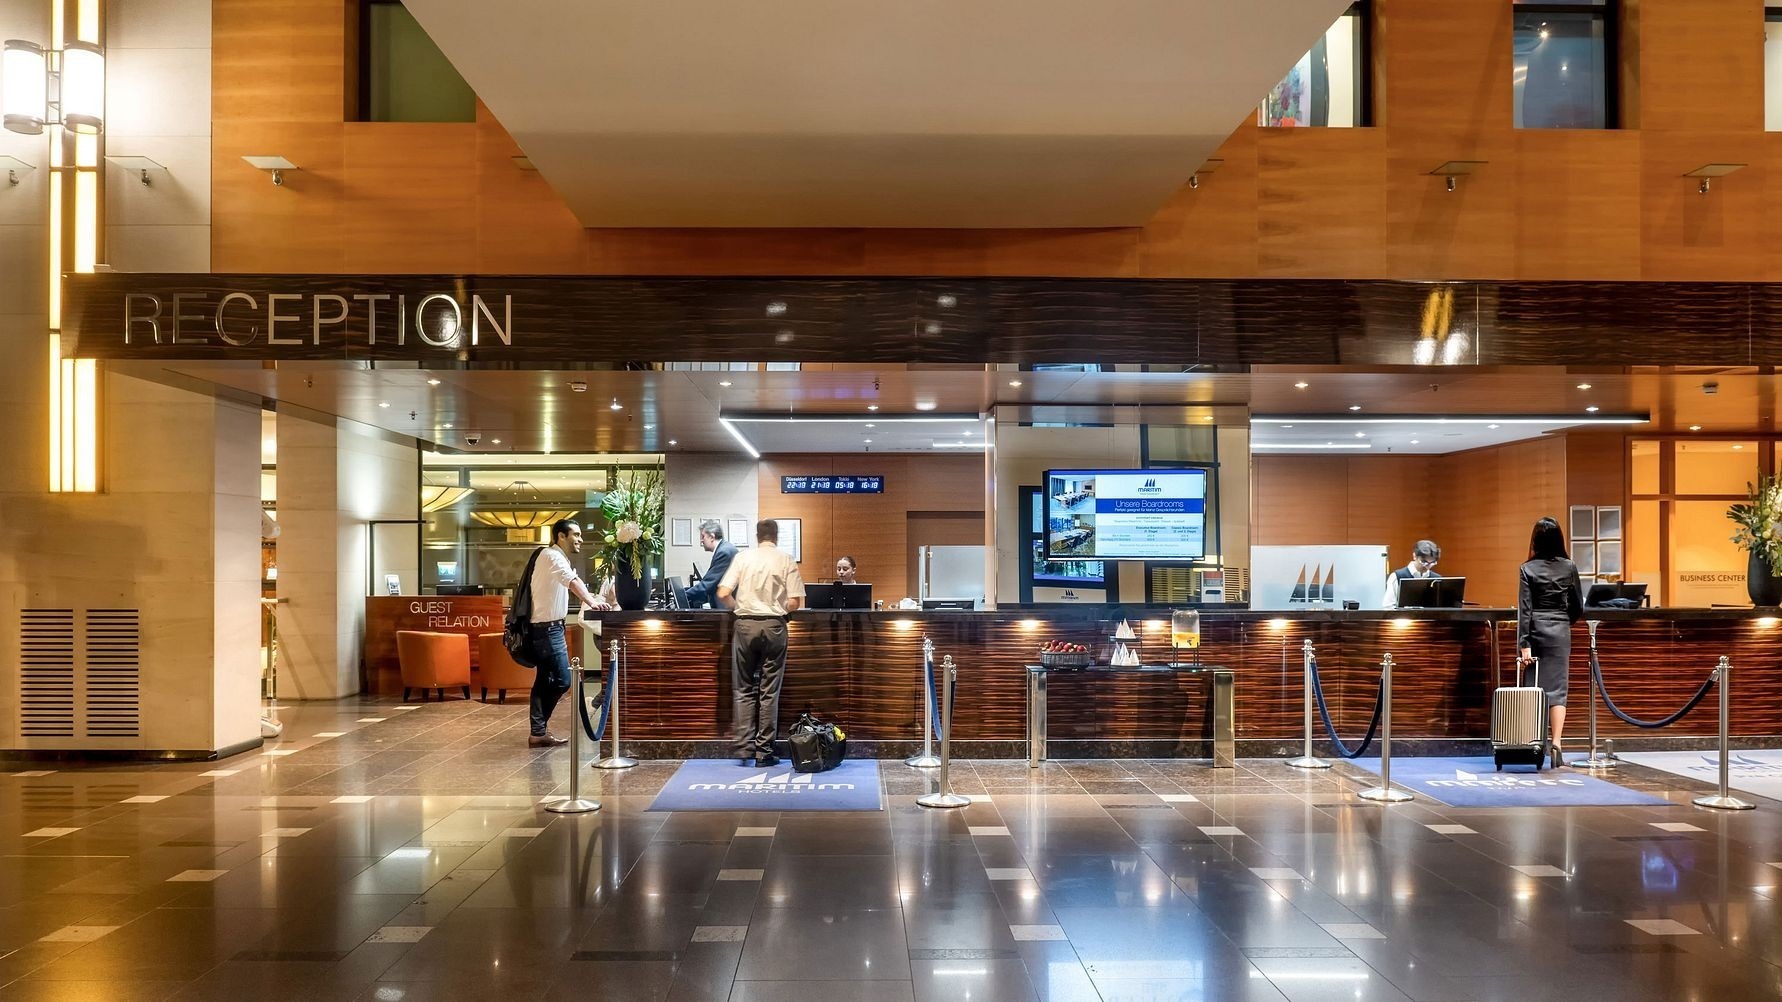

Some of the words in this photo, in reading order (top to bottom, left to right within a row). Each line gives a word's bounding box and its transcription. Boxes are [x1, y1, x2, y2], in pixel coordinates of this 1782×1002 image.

[125, 292, 512, 346] RECEPTION
[1115, 500, 1140, 508] Unsere
[1141, 500, 1184, 508] Boardrooms
[1680, 574, 1716, 582] BUSINESS
[1717, 574, 1746, 582] CENTER
[409, 601, 454, 614] GUEST
[428, 615, 490, 628] RELATION
